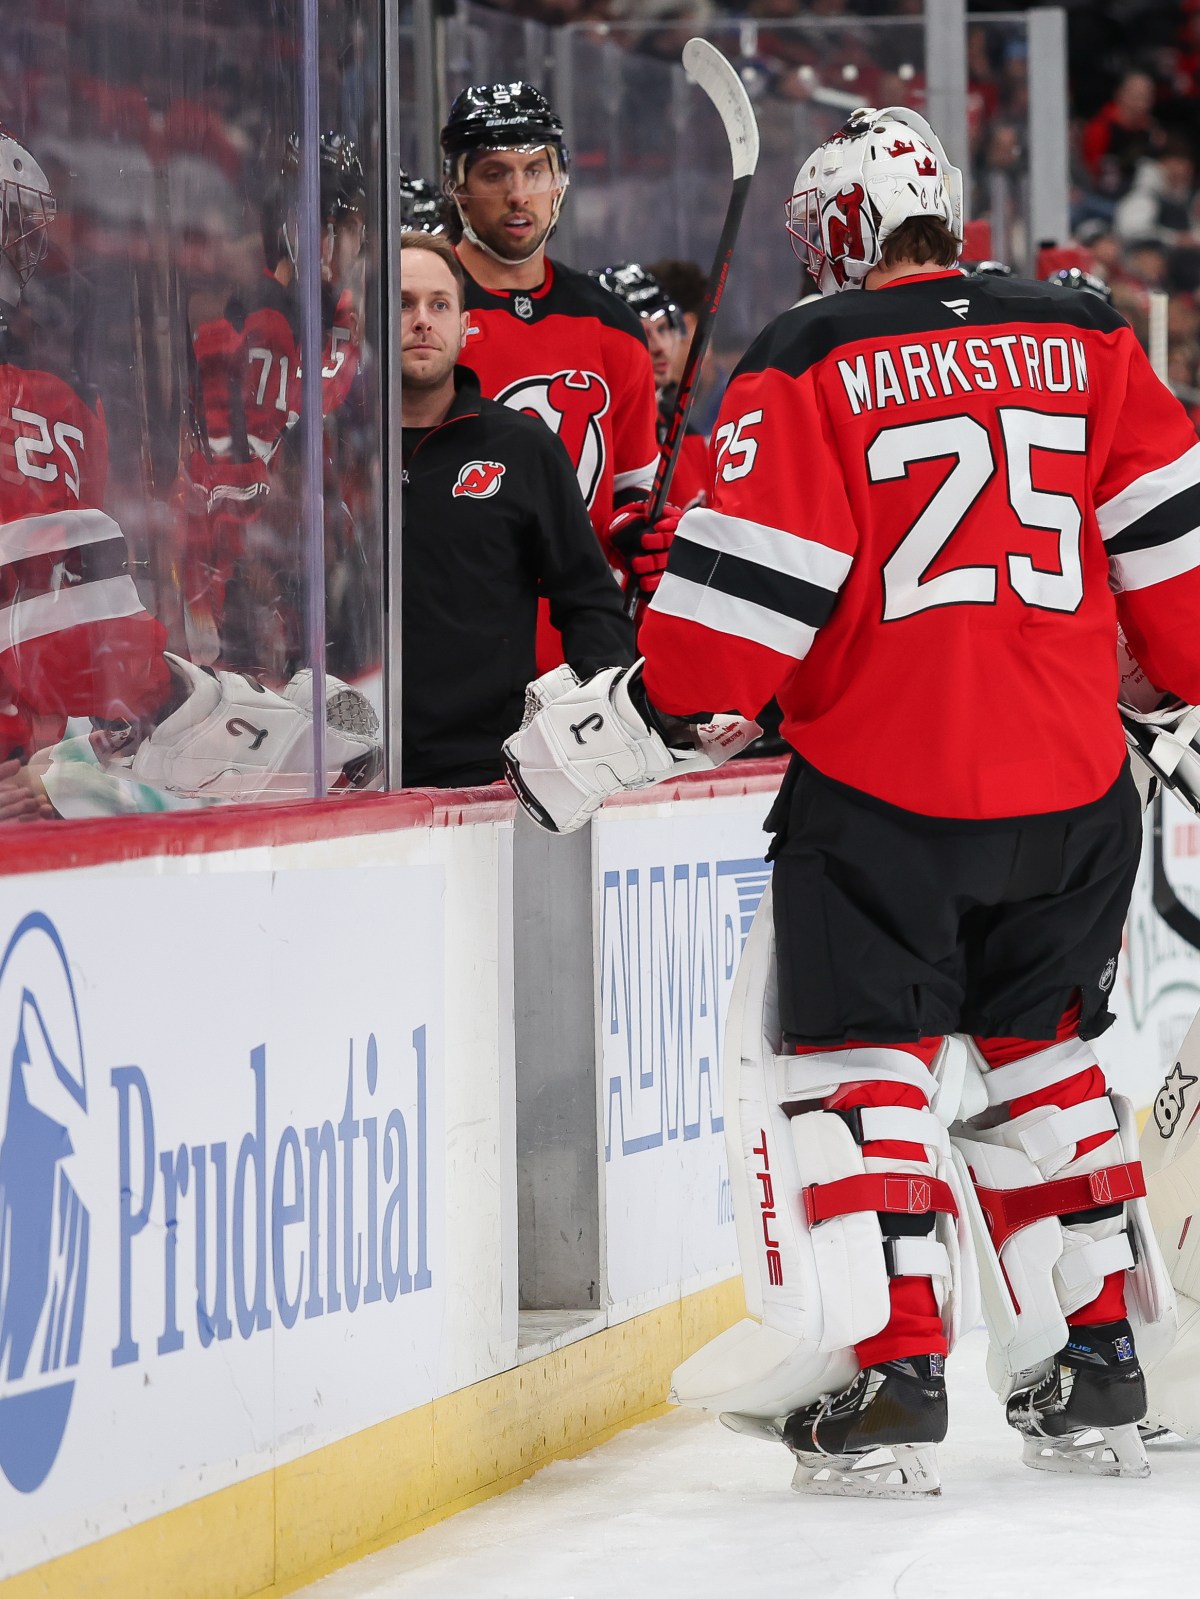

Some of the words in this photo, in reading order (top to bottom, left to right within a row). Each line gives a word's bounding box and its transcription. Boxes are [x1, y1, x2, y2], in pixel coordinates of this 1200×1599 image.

[485, 116, 529, 127] BAUER
[248, 347, 288, 412] 71
[837, 334, 1090, 415] MARKSTROM
[867, 407, 1087, 623] 25
[110, 1023, 432, 1369] Prudential
[752, 1127, 784, 1287] TRUE
[1067, 1341, 1092, 1353] RUE
